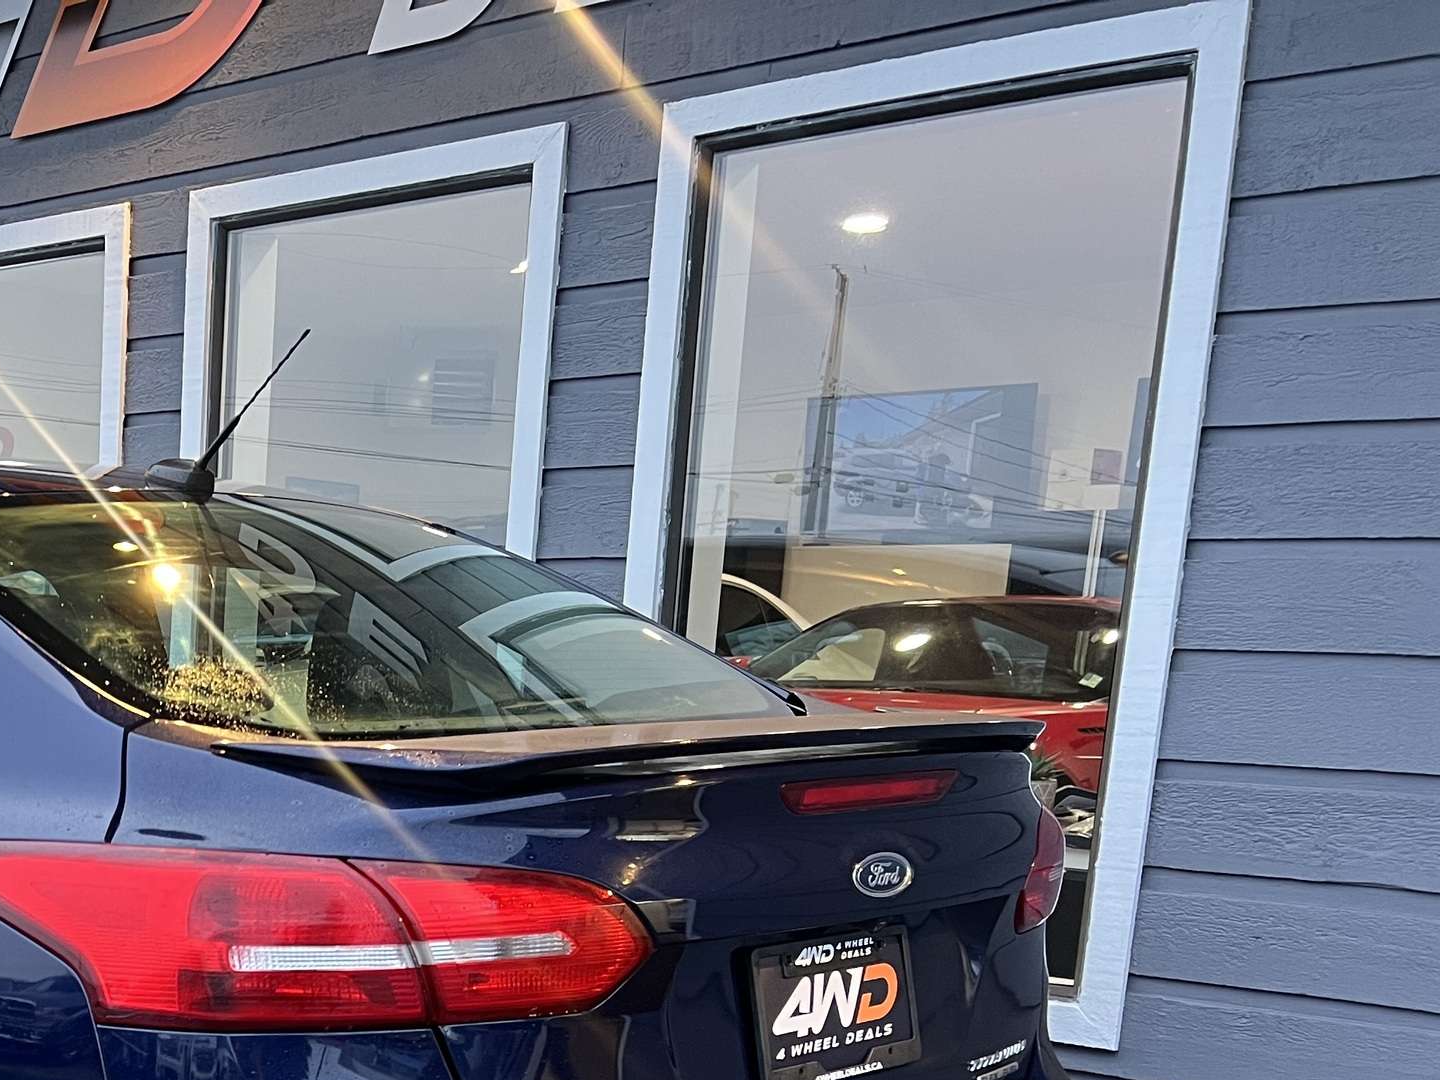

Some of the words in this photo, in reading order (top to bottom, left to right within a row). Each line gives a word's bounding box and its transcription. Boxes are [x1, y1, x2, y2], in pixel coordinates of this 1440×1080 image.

[868, 862, 901, 888] Ford
[794, 943, 835, 967] 4WD
[840, 947, 872, 960] DEALS
[772, 962, 898, 1038] 4WD
[776, 1047, 786, 1060] 4
[791, 1035, 840, 1058] WHEEL
[845, 1023, 893, 1045] DEALS
